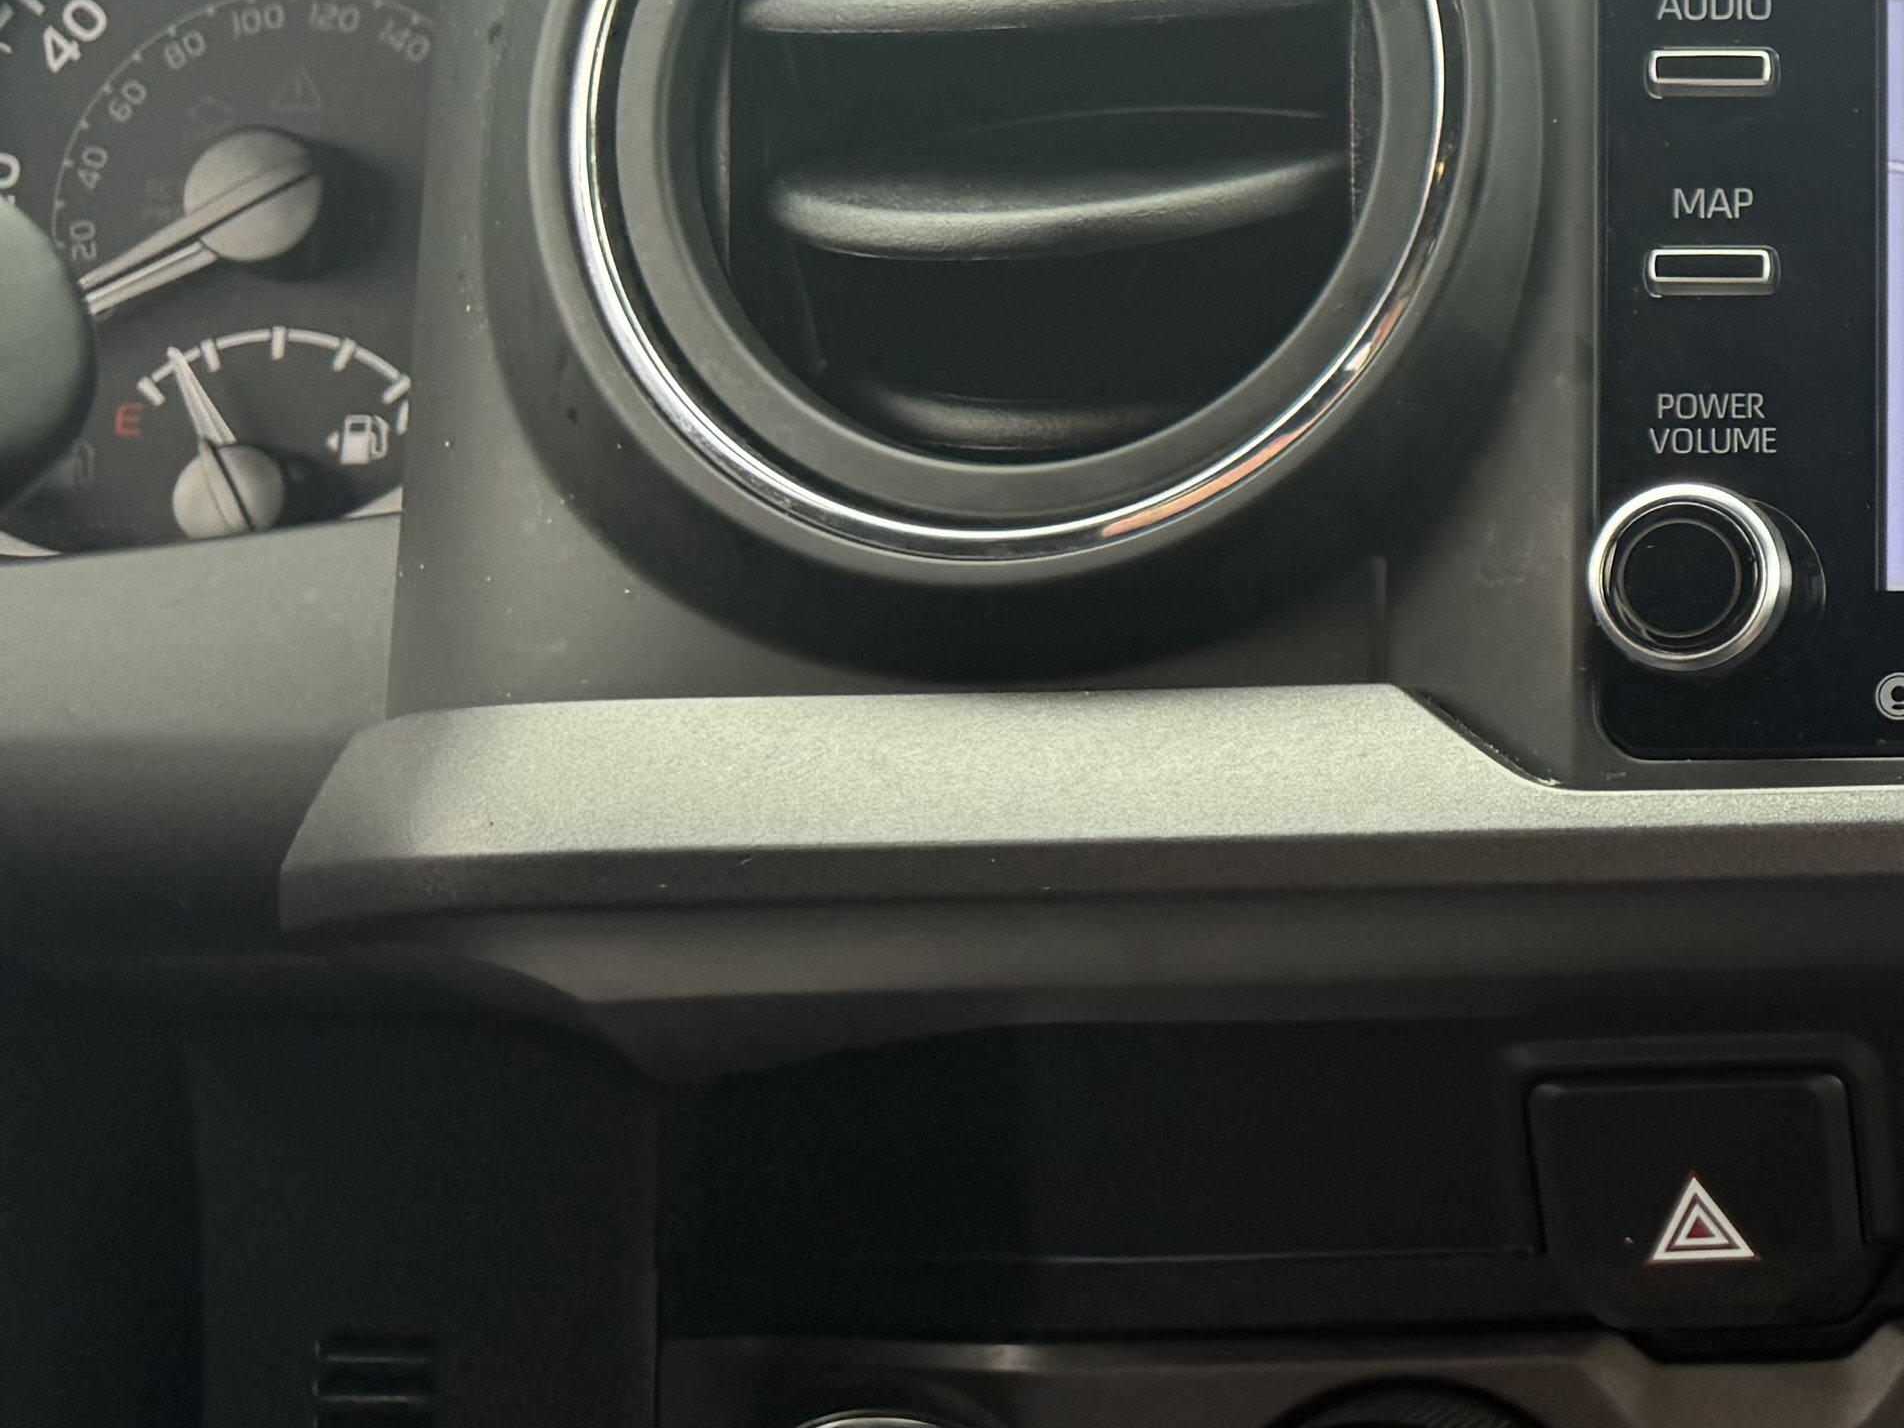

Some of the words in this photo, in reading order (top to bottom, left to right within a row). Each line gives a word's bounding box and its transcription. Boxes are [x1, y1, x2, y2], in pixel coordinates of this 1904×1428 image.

[231, 2, 285, 36] 100
[309, 1, 360, 33] 120
[163, 29, 206, 70] 80
[379, 19, 431, 62] 140
[108, 79, 147, 123] 60
[77, 146, 109, 190] 40
[1672, 187, 1754, 219] MAP
[69, 219, 98, 262] 20
[114, 403, 144, 439] E
[1657, 392, 1765, 420] POWER
[1648, 427, 1777, 455] VOLUME
